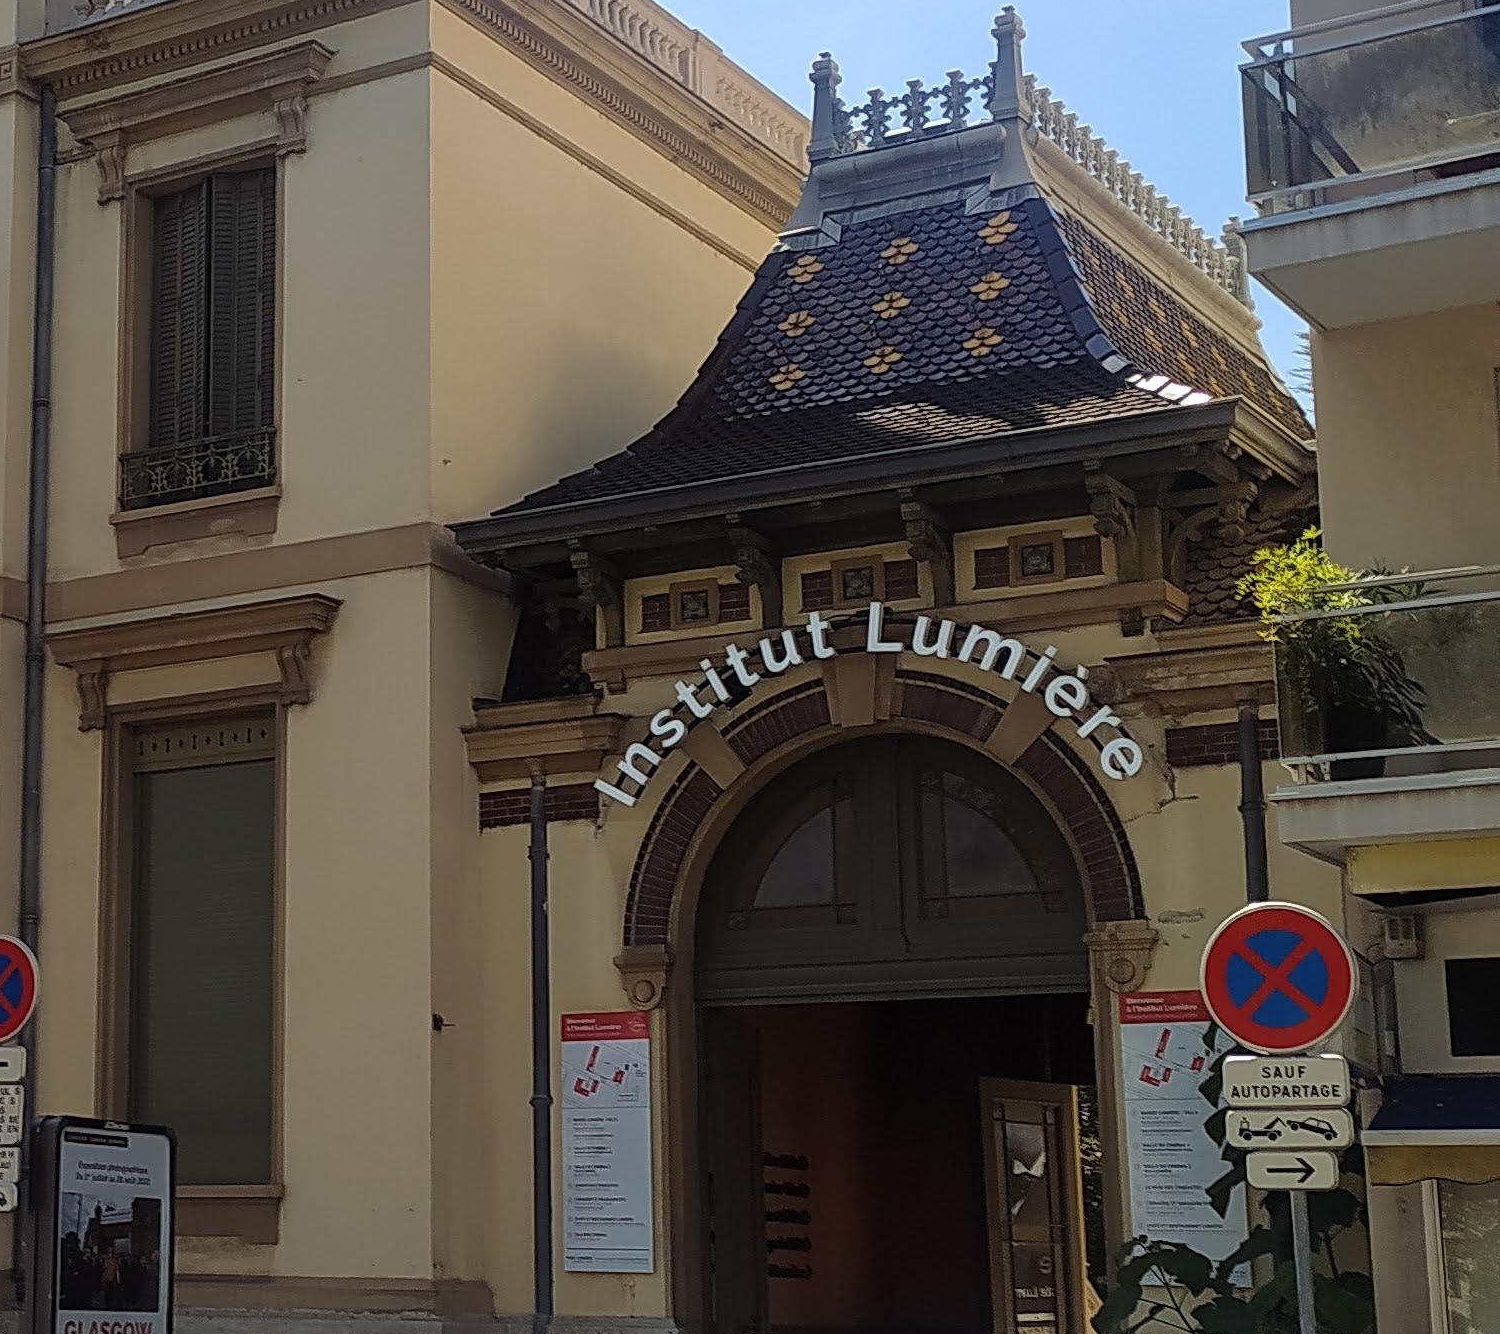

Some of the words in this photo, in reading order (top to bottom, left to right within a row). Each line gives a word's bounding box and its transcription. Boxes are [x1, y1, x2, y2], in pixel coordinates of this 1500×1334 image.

[593, 611, 836, 808] Institut
[865, 601, 1145, 782] Lumière
[1260, 1065, 1307, 1079] SAUF
[1230, 1084, 1342, 1099] AUTOPARTAGE
